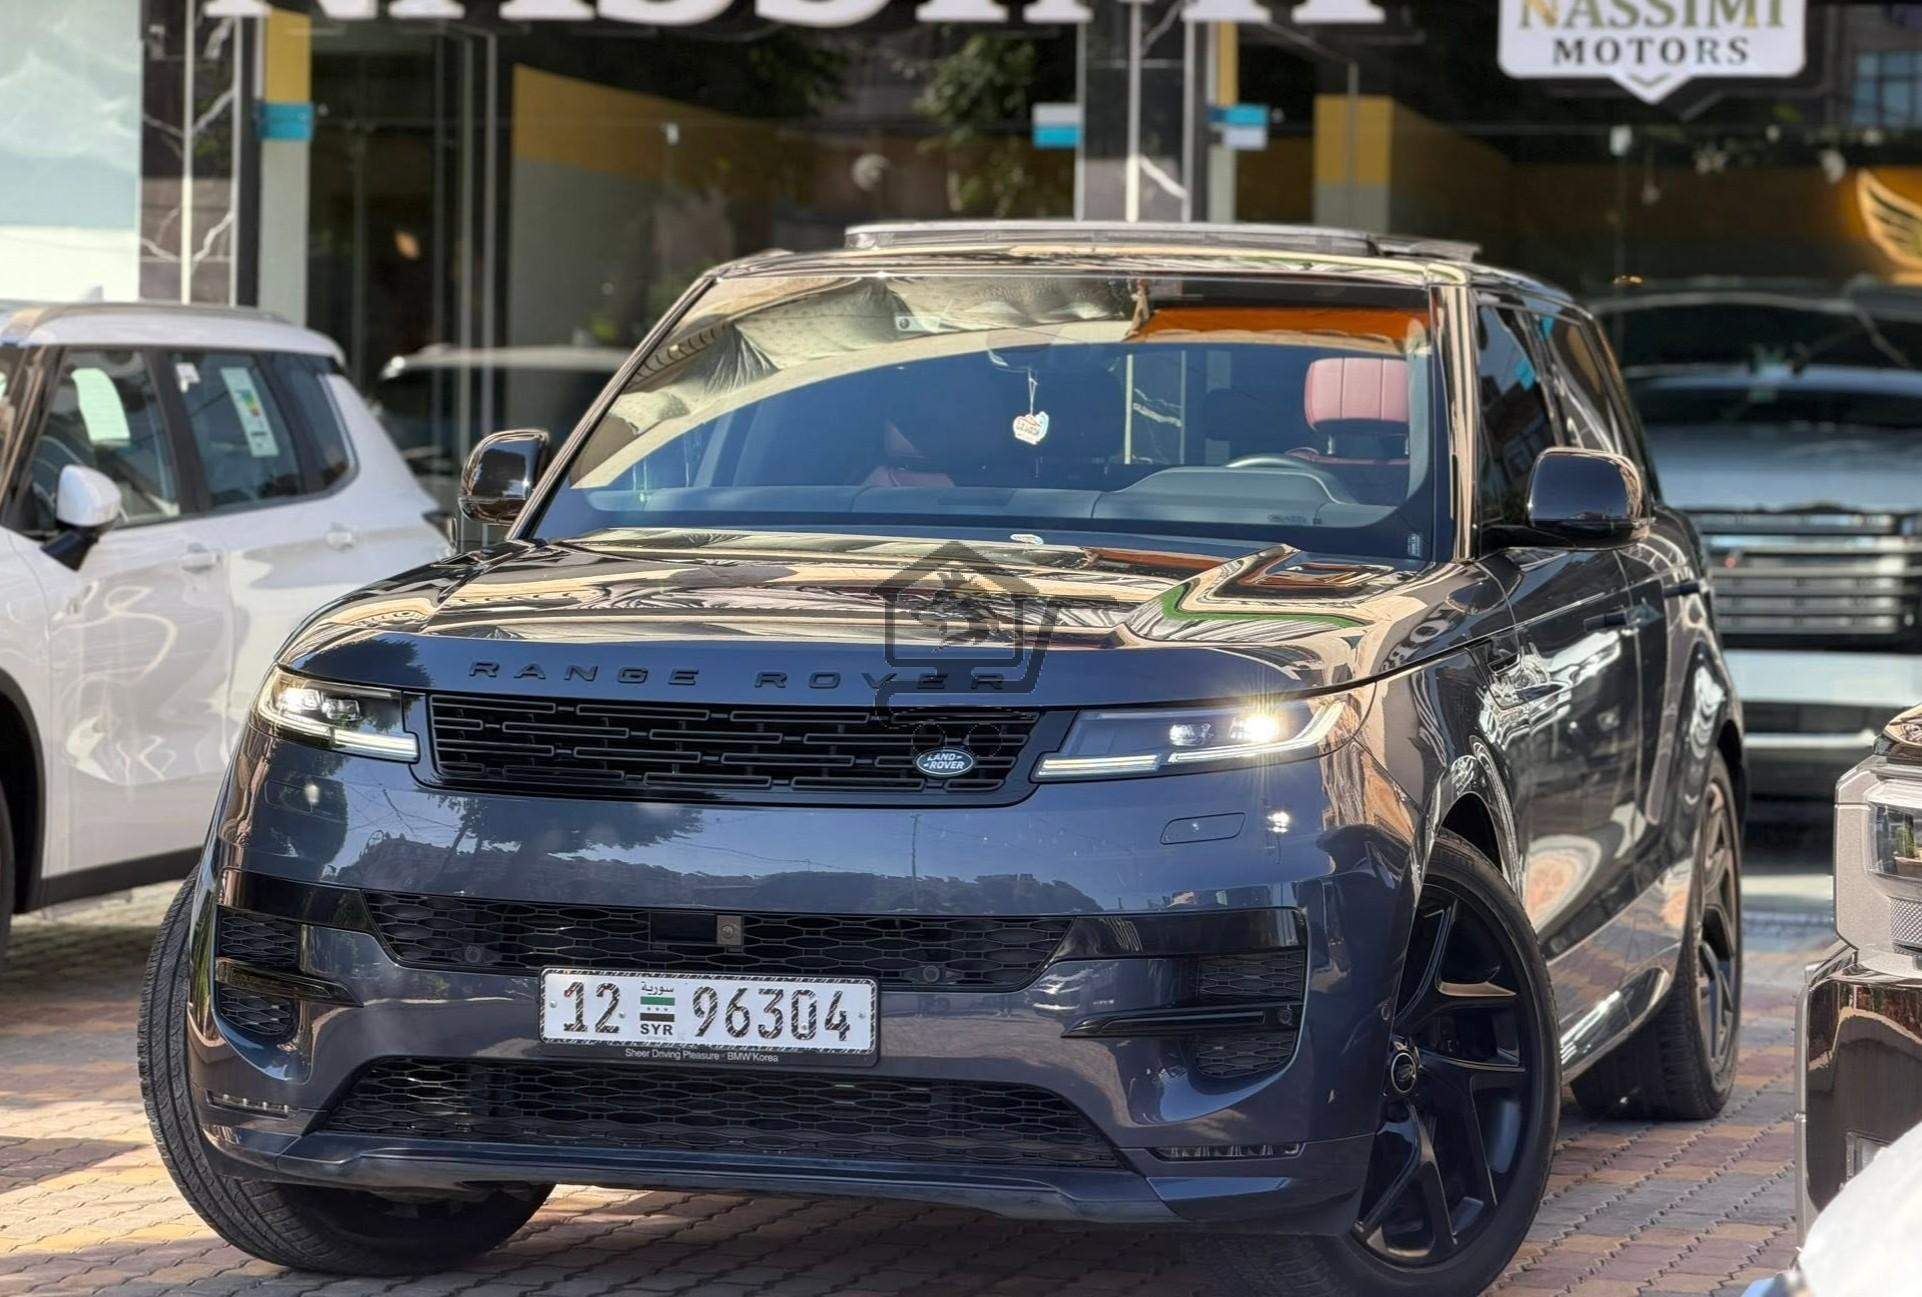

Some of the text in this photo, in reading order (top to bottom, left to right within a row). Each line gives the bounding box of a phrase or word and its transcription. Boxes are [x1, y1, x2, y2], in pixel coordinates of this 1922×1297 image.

[1552, 36, 1750, 66] MOTORS
[468, 660, 1005, 690] RANGE ROVER
[927, 753, 957, 761] LAND
[929, 761, 965, 769] ROVER
[641, 981, 675, 996] سورية
[563, 981, 851, 1042] 12 96304
[640, 1023, 673, 1036] SYR
[625, 1048, 779, 1063] Sheer Driving Pleasure BMW Korea
